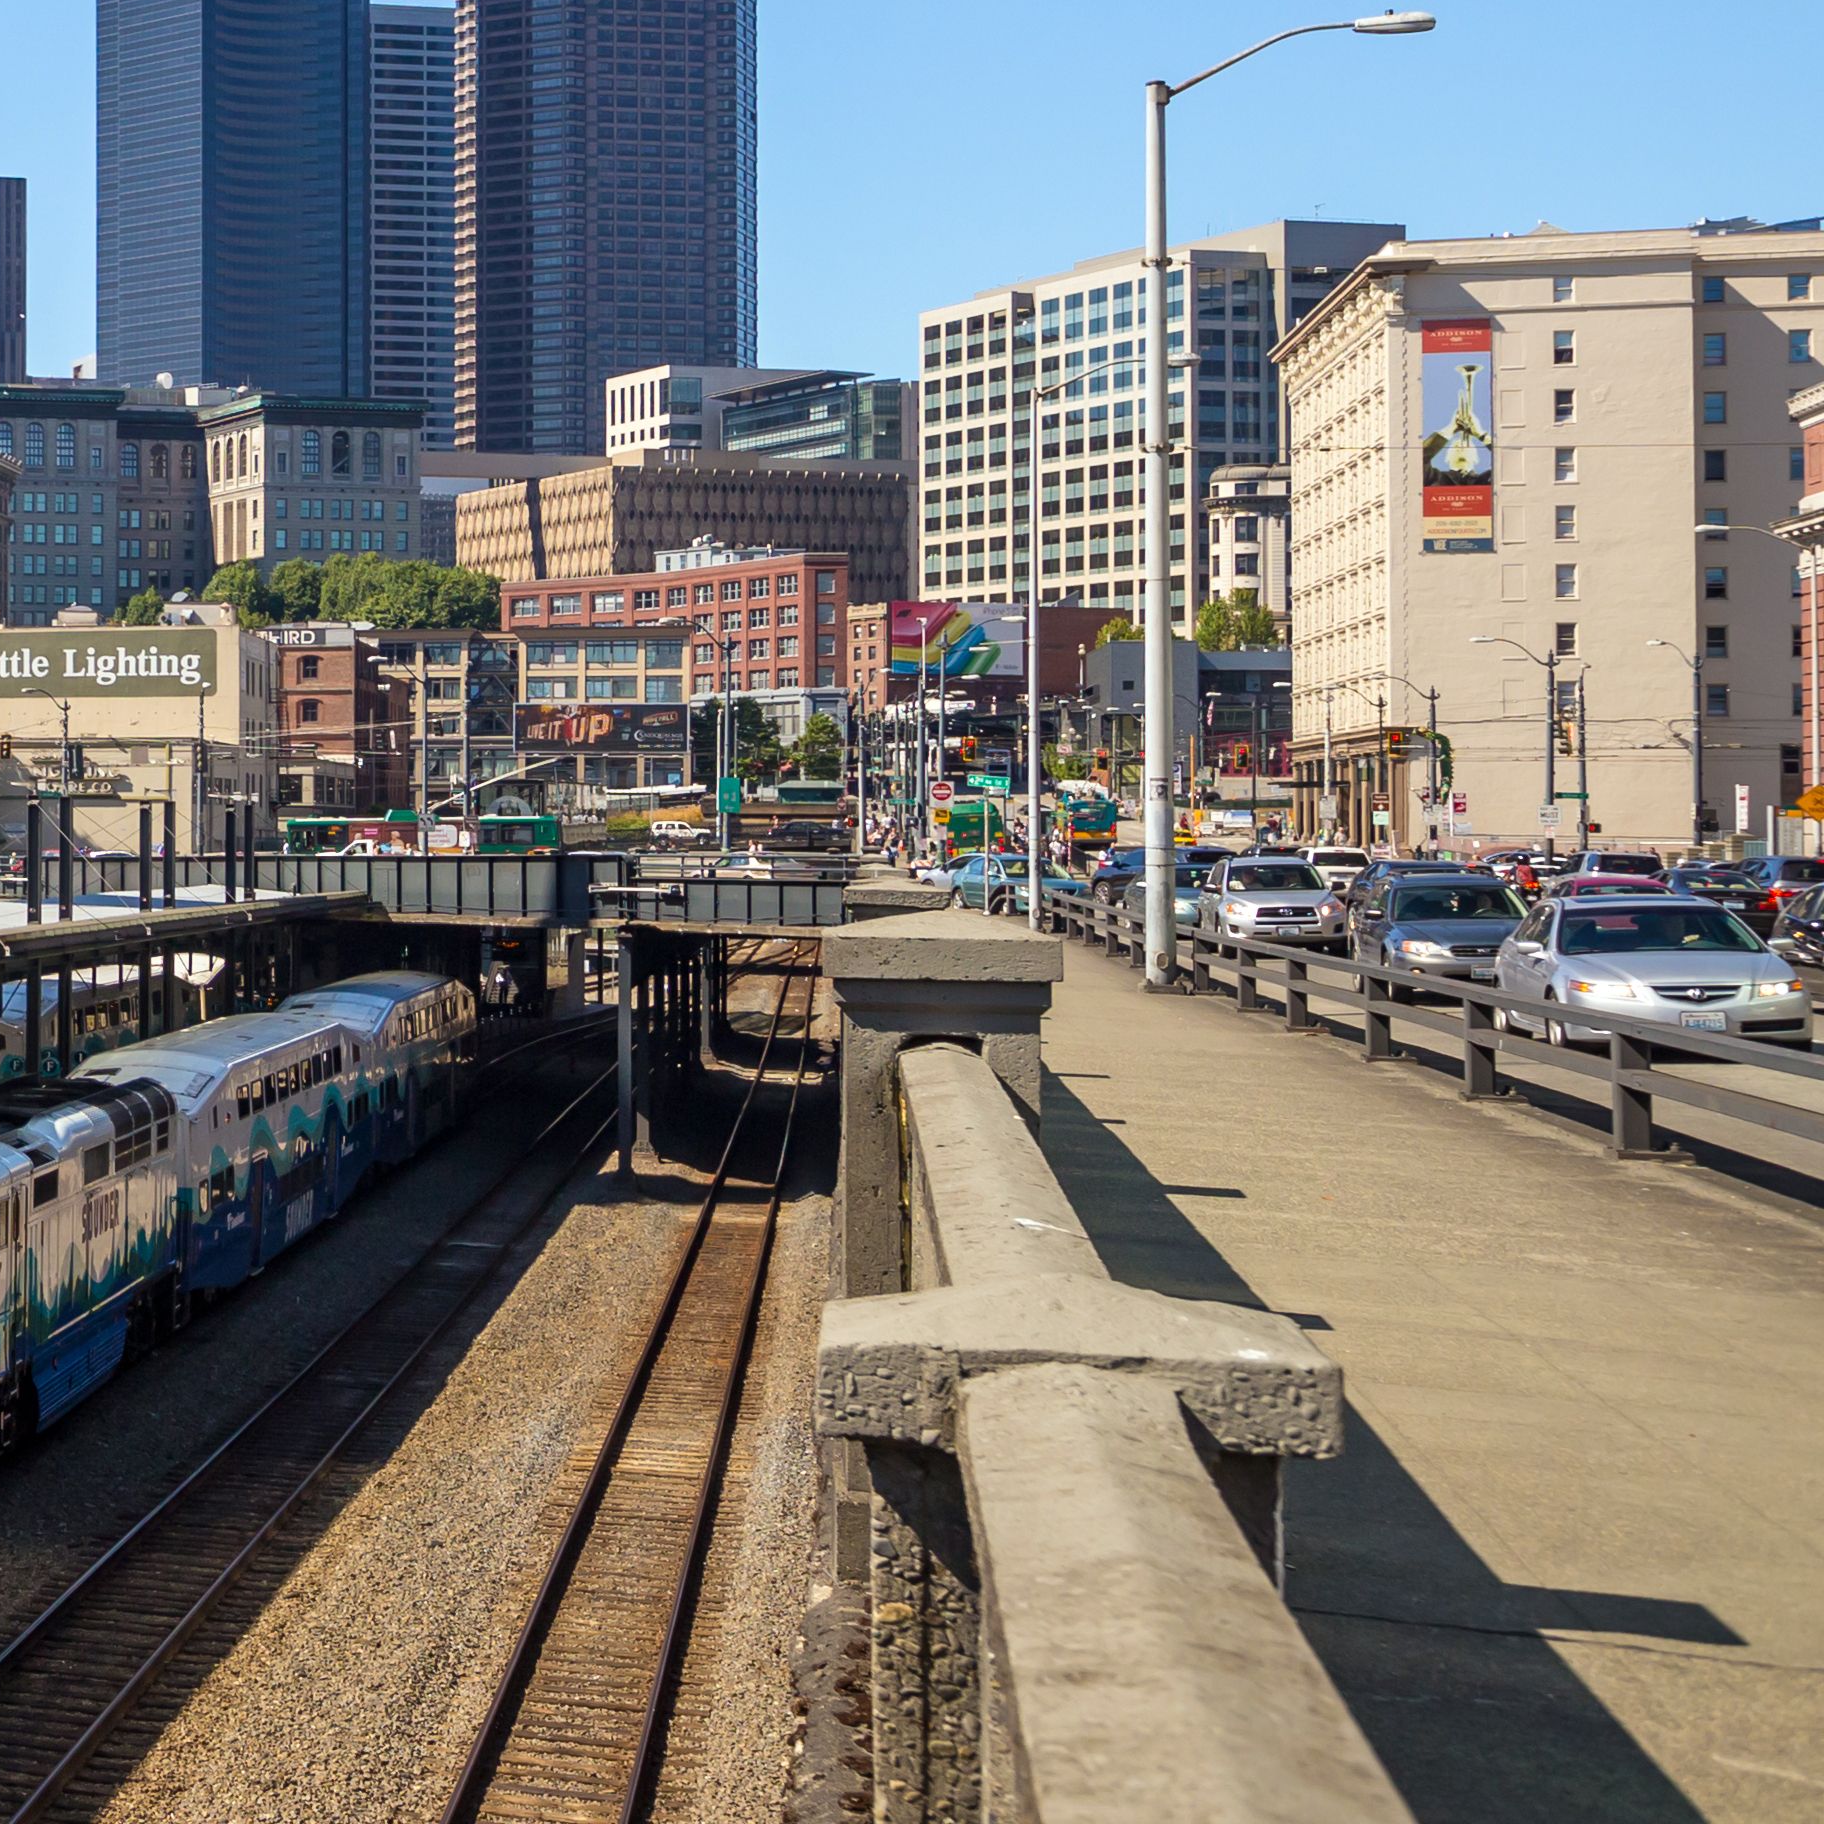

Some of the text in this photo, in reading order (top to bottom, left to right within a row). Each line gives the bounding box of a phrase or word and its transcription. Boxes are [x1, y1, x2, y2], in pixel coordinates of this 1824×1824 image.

[1430, 329, 1483, 337] ADDISON
[63, 647, 201, 685] Lighting
[571, 714, 613, 743] UP
